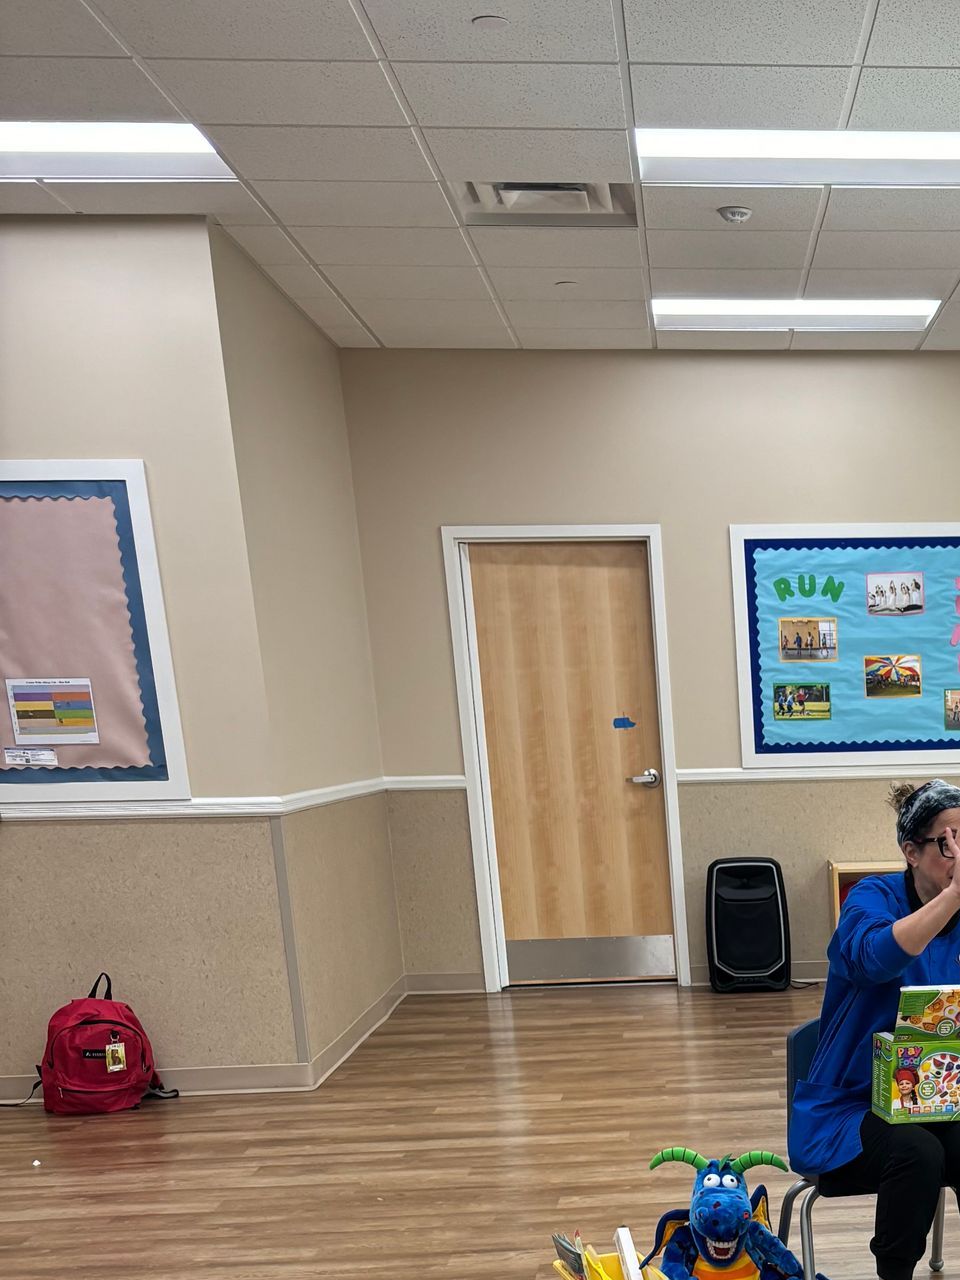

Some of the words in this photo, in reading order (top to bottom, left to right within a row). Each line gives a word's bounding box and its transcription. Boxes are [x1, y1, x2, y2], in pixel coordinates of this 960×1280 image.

[773, 574, 845, 603] RUN
[897, 1046, 924, 1058] Play
[899, 1057, 921, 1067] Food
